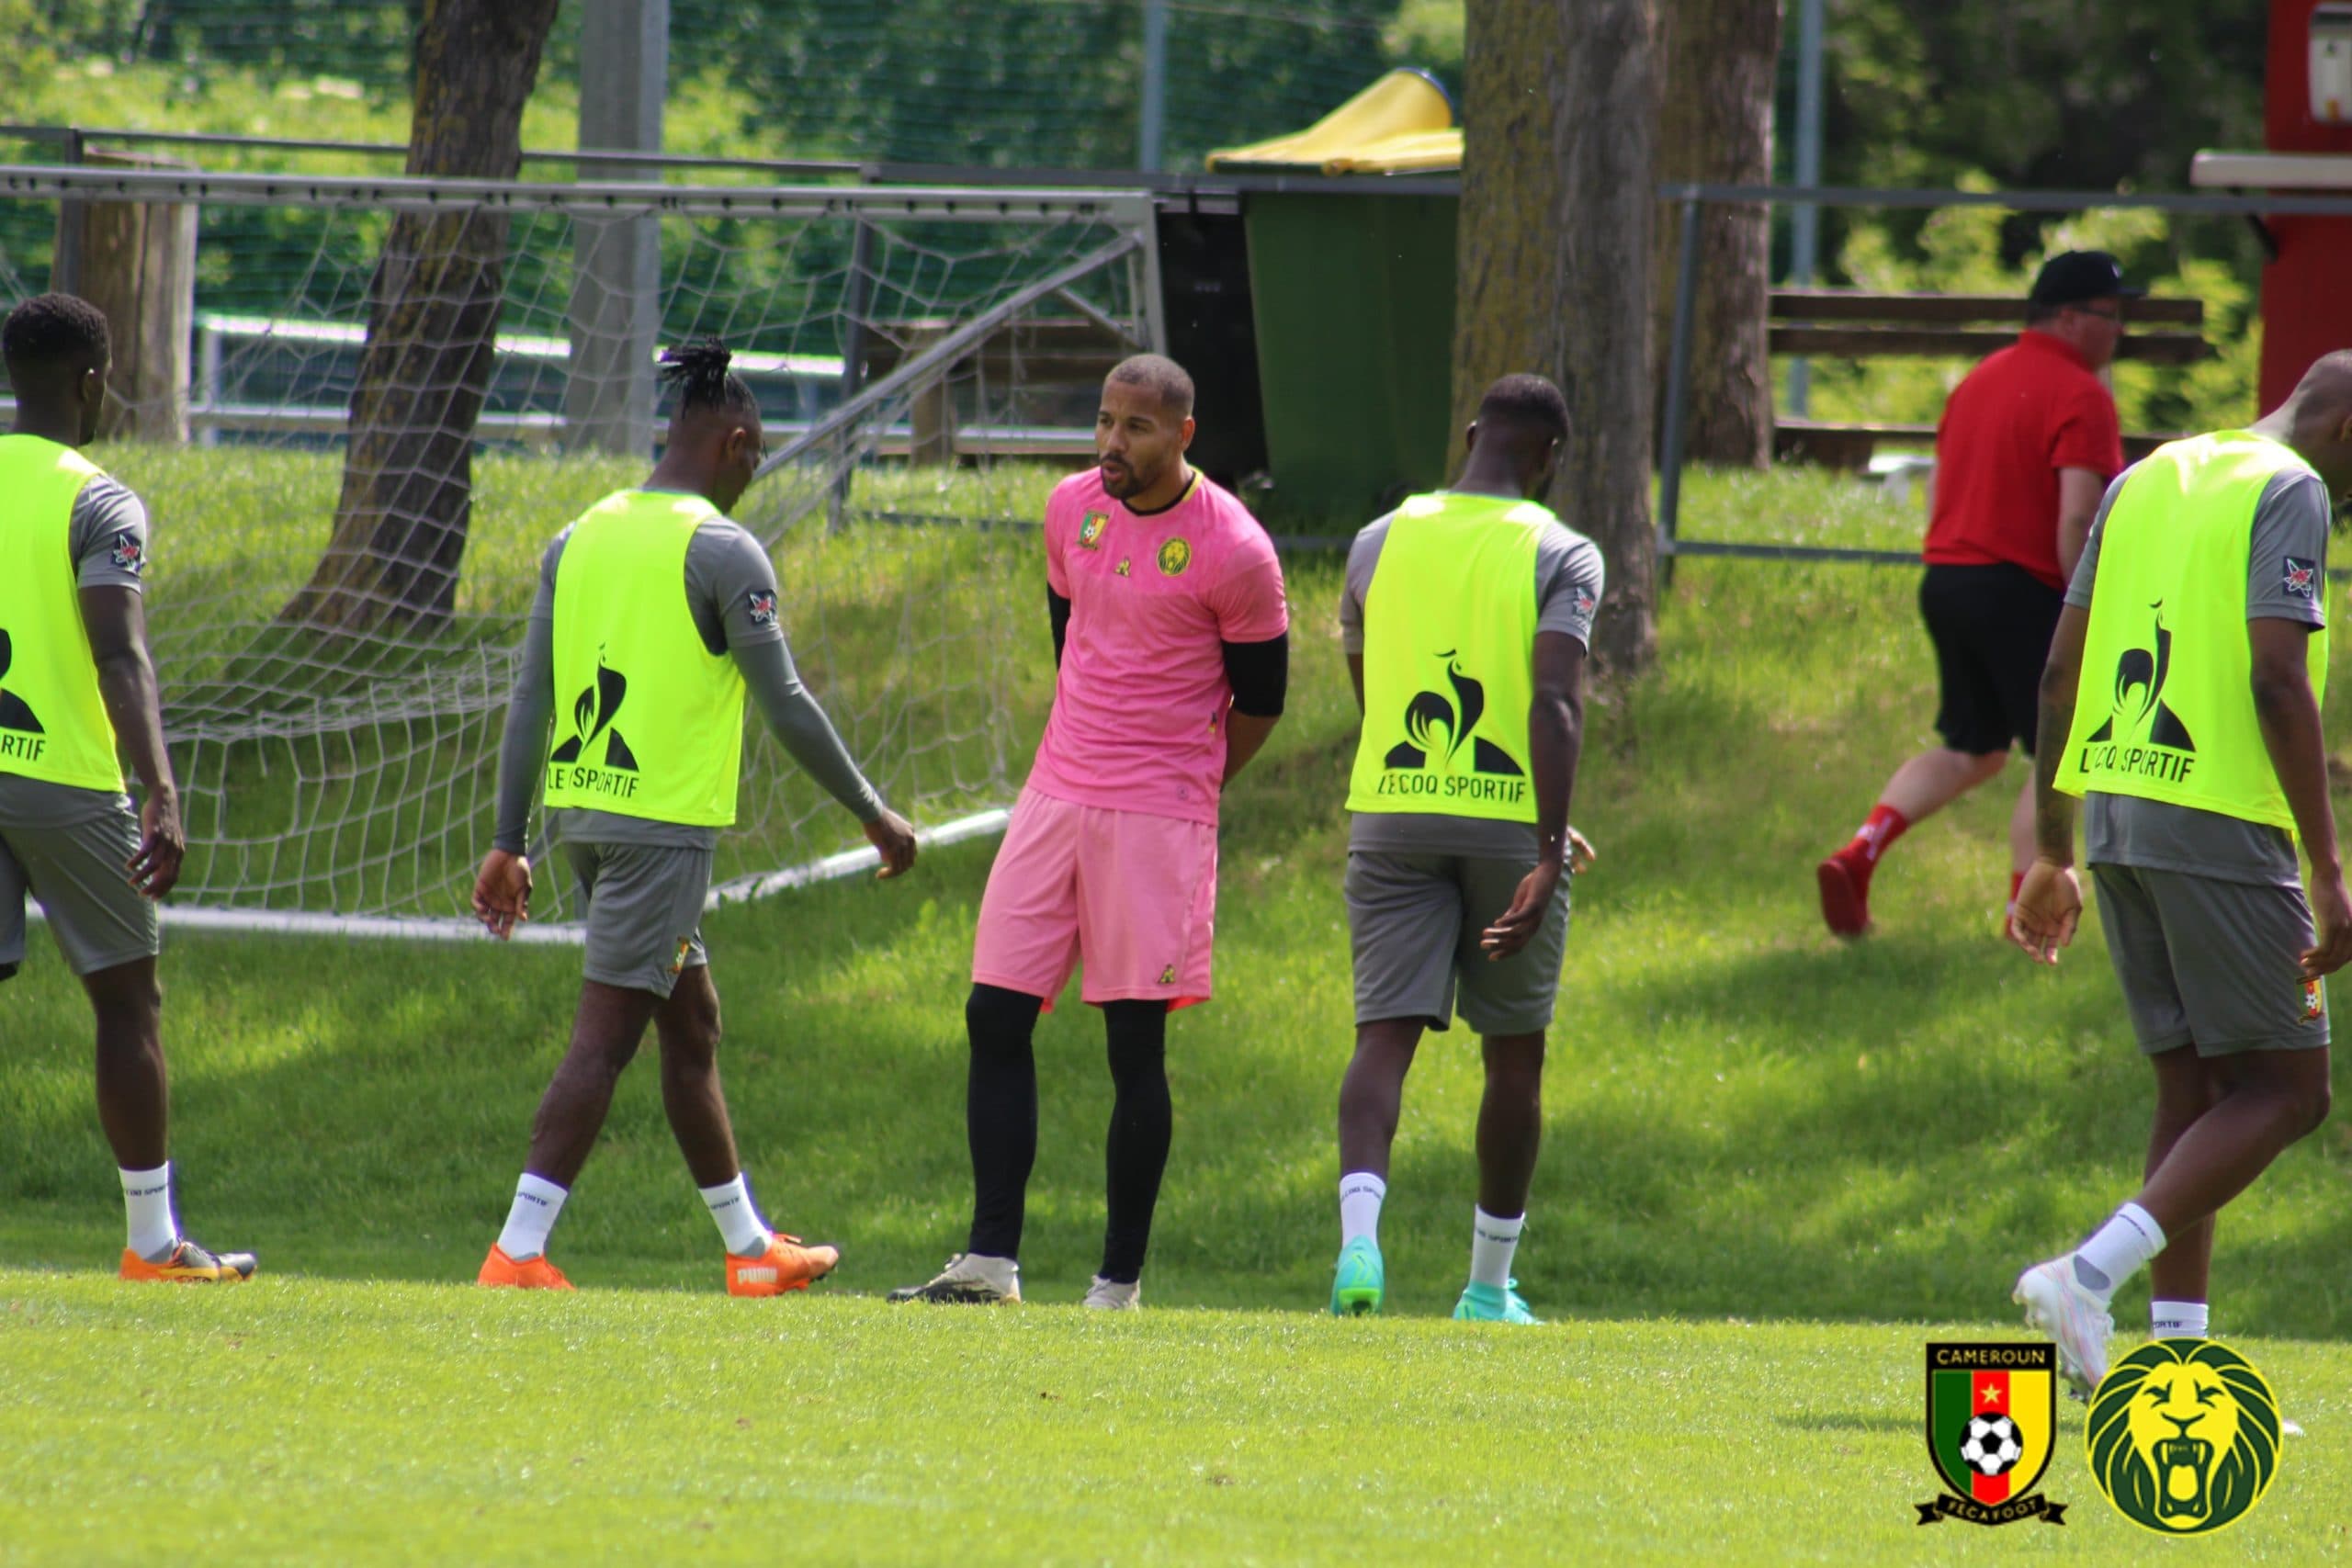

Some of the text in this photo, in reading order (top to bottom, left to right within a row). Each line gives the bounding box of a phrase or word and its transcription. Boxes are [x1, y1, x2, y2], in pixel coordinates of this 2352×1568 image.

[548, 768, 565, 790] LE
[573, 766, 639, 798] SPORTIF
[1398, 773, 1438, 795] COQ
[1444, 774, 1526, 803] SPORTIF
